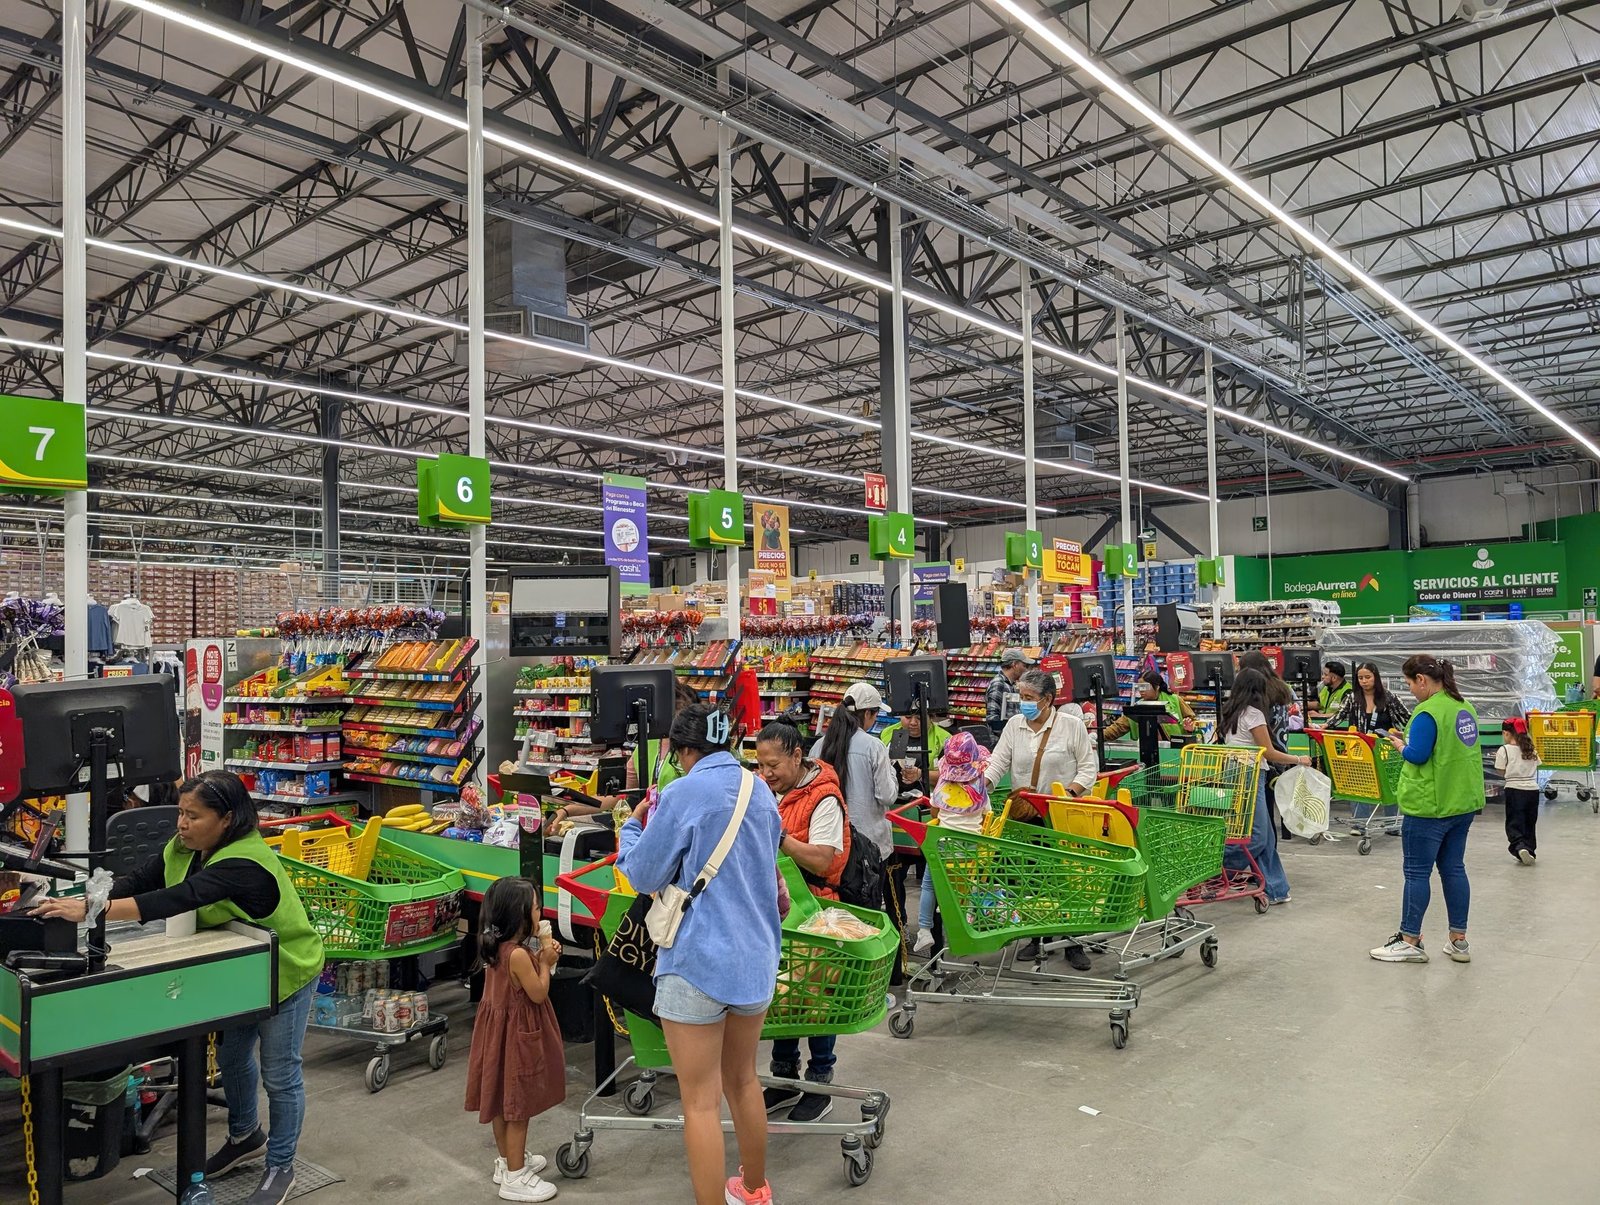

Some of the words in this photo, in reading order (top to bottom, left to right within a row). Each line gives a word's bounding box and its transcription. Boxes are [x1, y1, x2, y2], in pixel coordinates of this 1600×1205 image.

[28, 426, 55, 461] 7
[457, 476, 473, 503] 6
[606, 498, 629, 507] Programa
[721, 507, 733, 529] 5
[897, 527, 907, 546] 4
[1031, 542, 1038, 559] 3
[1055, 541, 1079, 553] PRECIOS
[758, 551, 786, 559] PRECIOS
[1127, 554, 1134, 569] 2
[1057, 560, 1080, 571] TOCAN
[1217, 566, 1222, 578] 1
[1413, 577, 1479, 590] SERVICIOS
[1482, 575, 1499, 587] AL
[1503, 572, 1559, 586] CLIENTE
[1419, 592, 1440, 600] Cobro
[1442, 591, 1451, 599] de
[1453, 590, 1477, 599] Dinero
[758, 599, 768, 615] $5
[228, 643, 235, 652] Z
[1553, 661, 1577, 669] para
